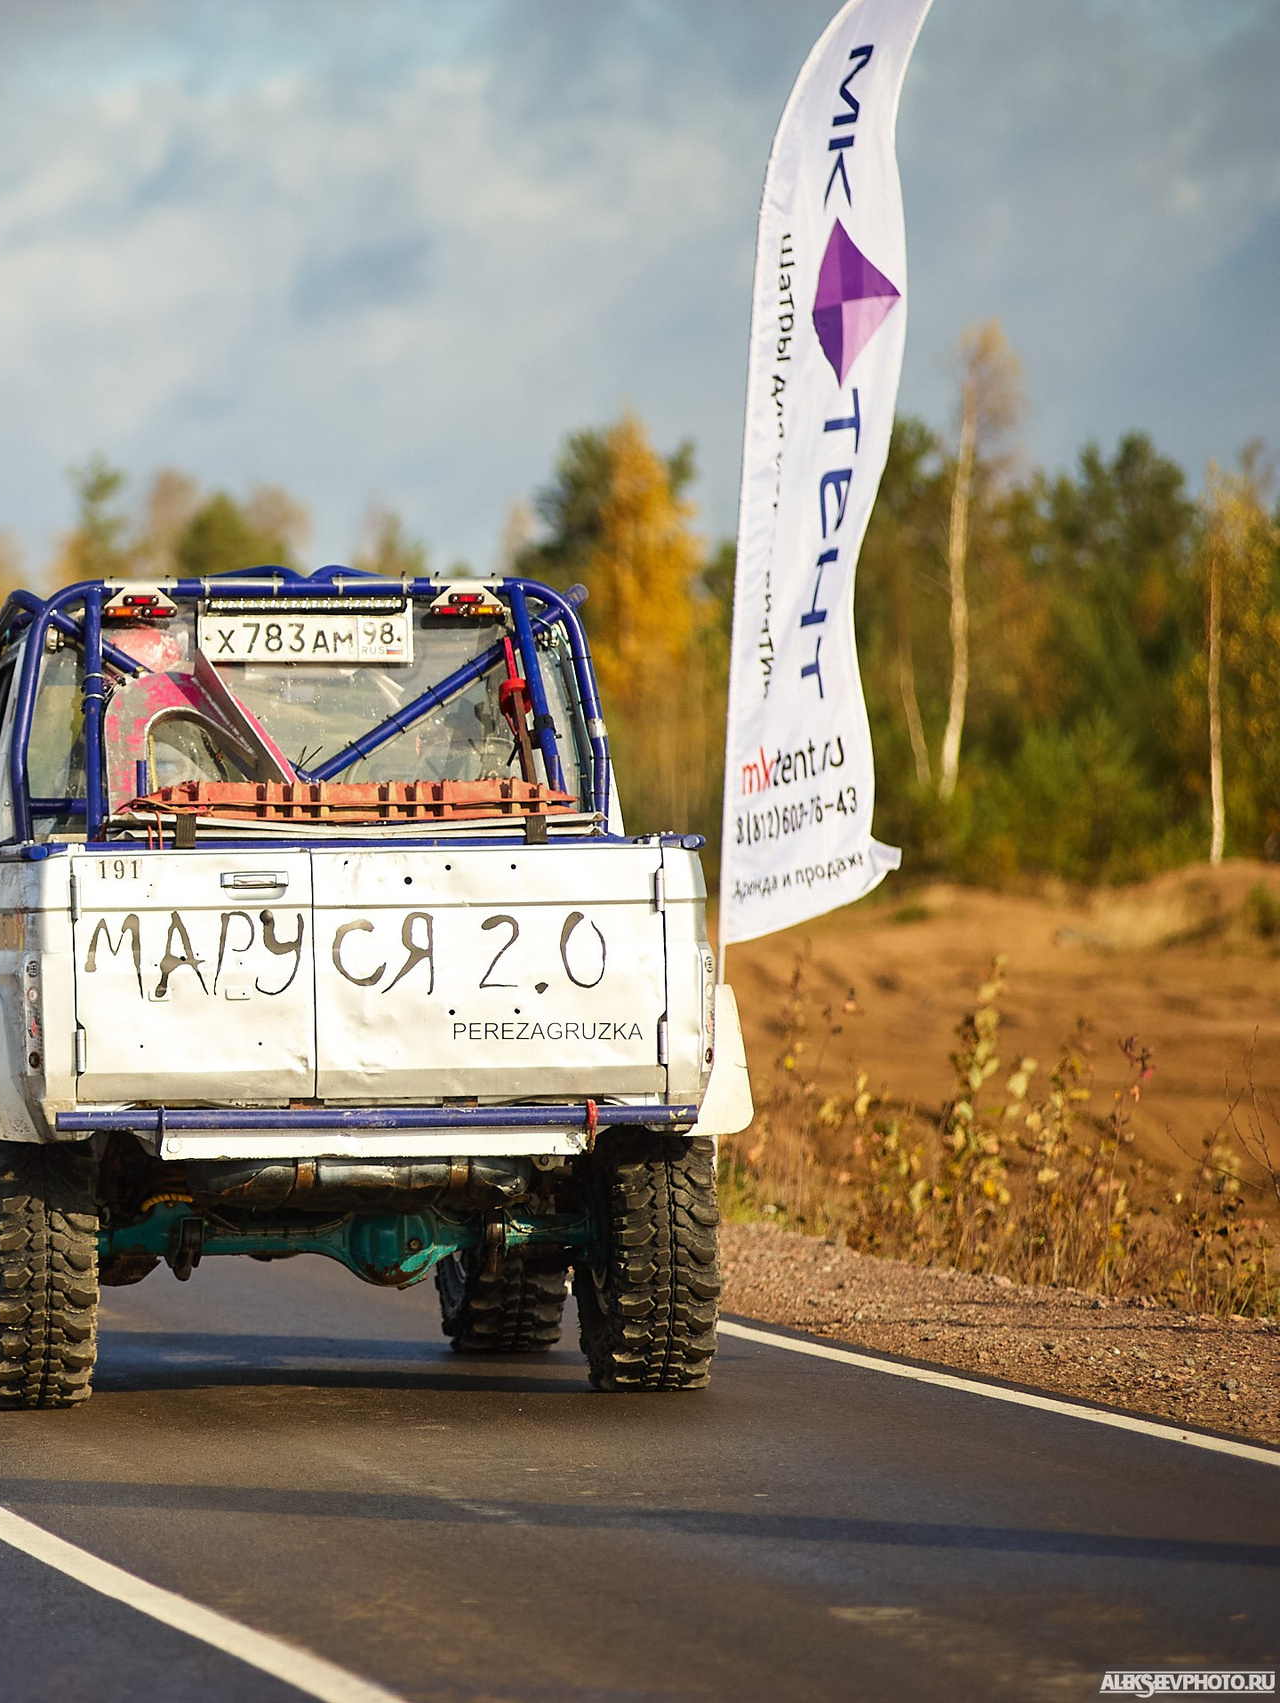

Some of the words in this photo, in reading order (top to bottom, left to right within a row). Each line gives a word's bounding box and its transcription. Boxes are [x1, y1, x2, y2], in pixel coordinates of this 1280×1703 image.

[361, 646, 386, 656] RUS
[98, 859, 139, 880] 191
[479, 911, 606, 994] 2.0
[452, 1022, 644, 1041] PEREZAGRUZKA
